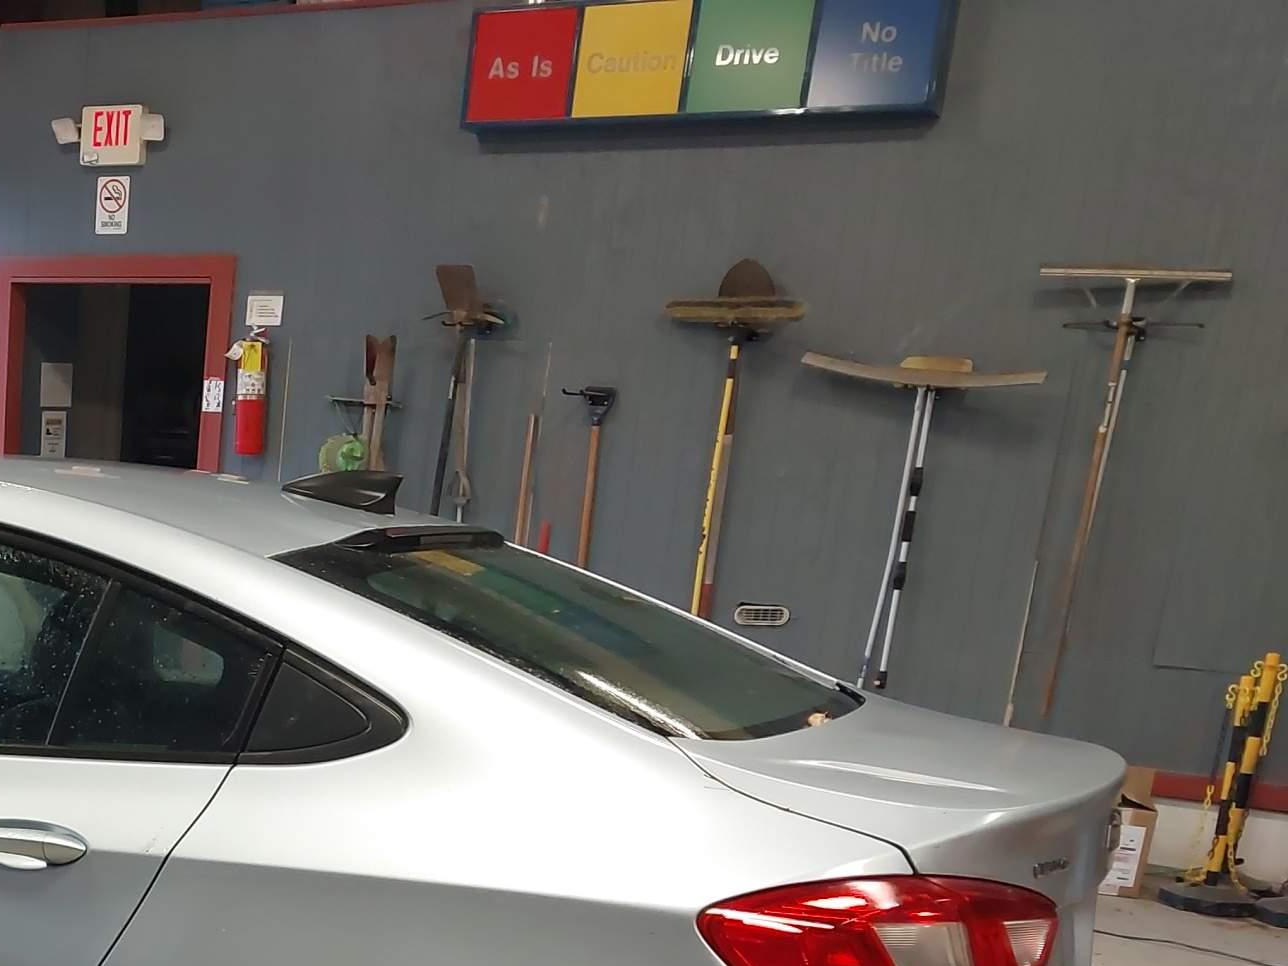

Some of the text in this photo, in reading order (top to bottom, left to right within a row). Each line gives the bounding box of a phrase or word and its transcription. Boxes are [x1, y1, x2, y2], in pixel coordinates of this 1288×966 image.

[861, 22, 897, 43] No
[587, 51, 677, 75] Caution
[715, 44, 780, 66] Drive
[849, 52, 903, 73] Title
[488, 56, 552, 79] As Is
[92, 109, 132, 147] EXIT
